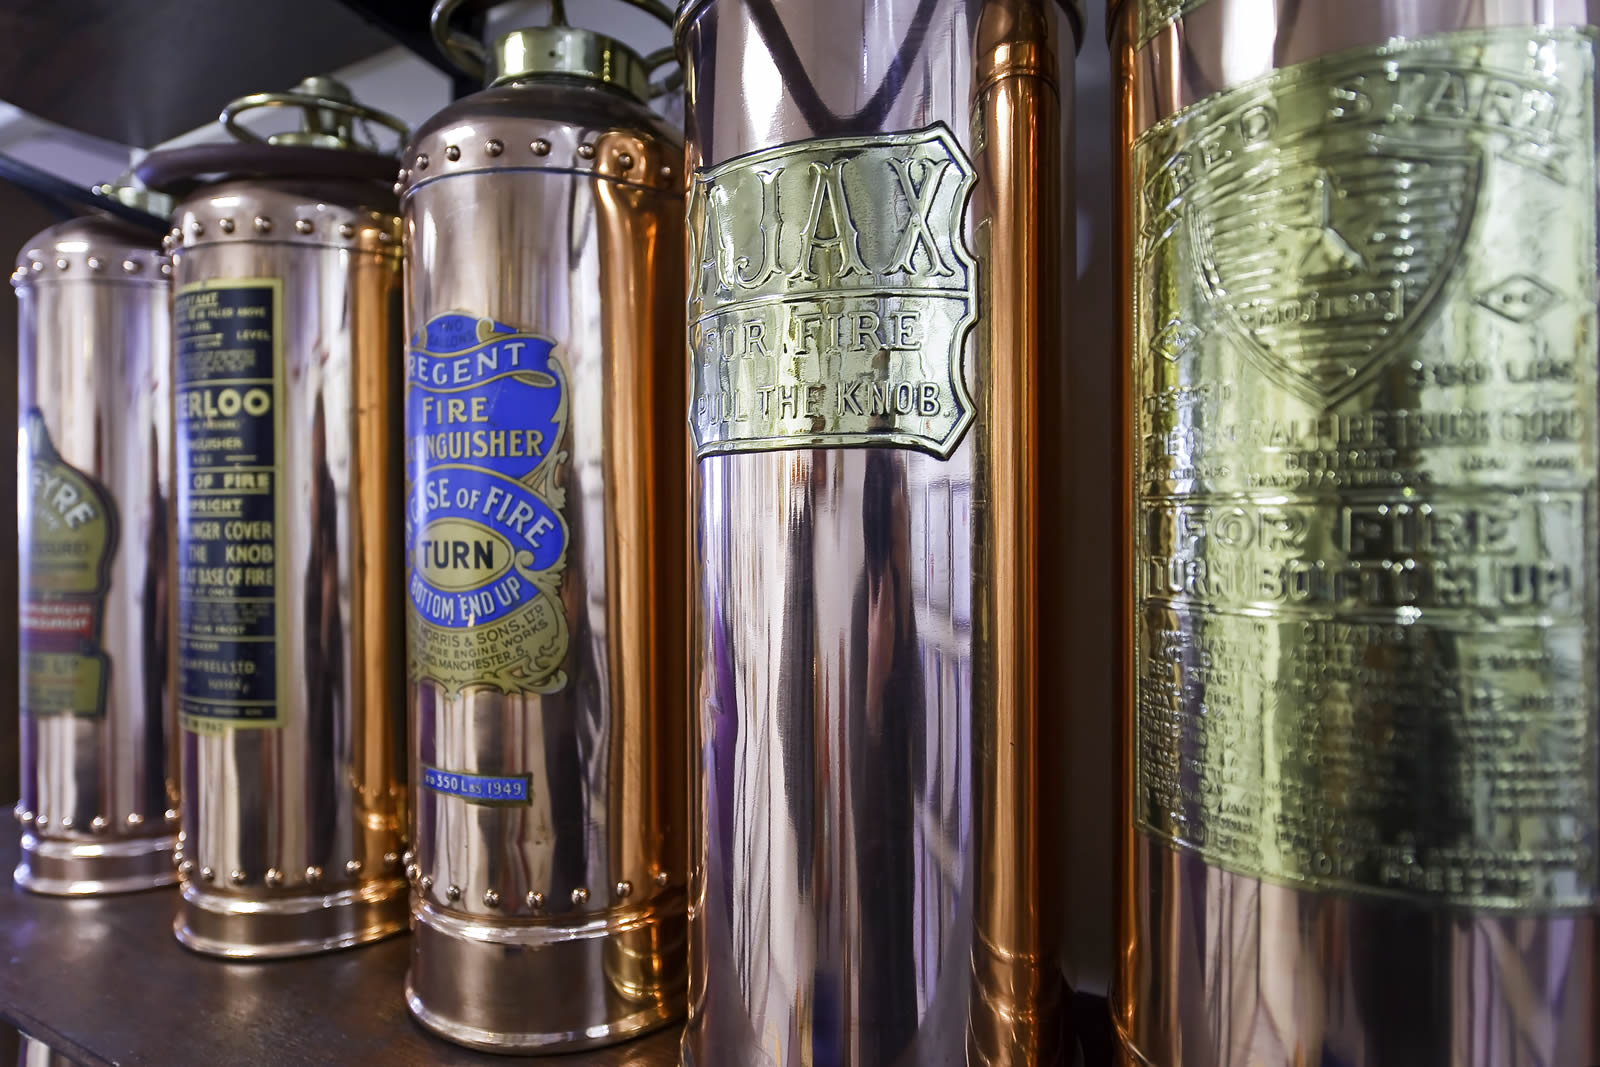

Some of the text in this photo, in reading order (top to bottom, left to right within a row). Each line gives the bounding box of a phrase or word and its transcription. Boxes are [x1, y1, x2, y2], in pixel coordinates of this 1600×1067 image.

[1169, 104, 1278, 193] RED
[692, 157, 955, 304] AJAX
[702, 310, 923, 367] FOR FIRE
[408, 341, 526, 385] REGENT
[422, 396, 489, 427] FIRE
[757, 383, 821, 422] THE
[837, 381, 951, 418] KNOB.
[193, 473, 269, 489] OF FIRE
[224, 521, 273, 540] COVER
[456, 487, 481, 509] OF
[482, 486, 555, 548] FIRE
[1177, 505, 1518, 556] FOR FIRE
[225, 545, 273, 562] KNOB
[421, 540, 494, 569] TURN
[199, 568, 224, 586] BASE
[226, 568, 242, 586] OF
[245, 567, 273, 586] FIRE
[1148, 555, 1233, 597] TURN
[1499, 562, 1572, 605] UP
[410, 576, 522, 623] BOTTOM END UP
[429, 619, 549, 659] FIRE ENGINE WORKS
[464, 637, 474, 648] &
[436, 774, 459, 791] 350
